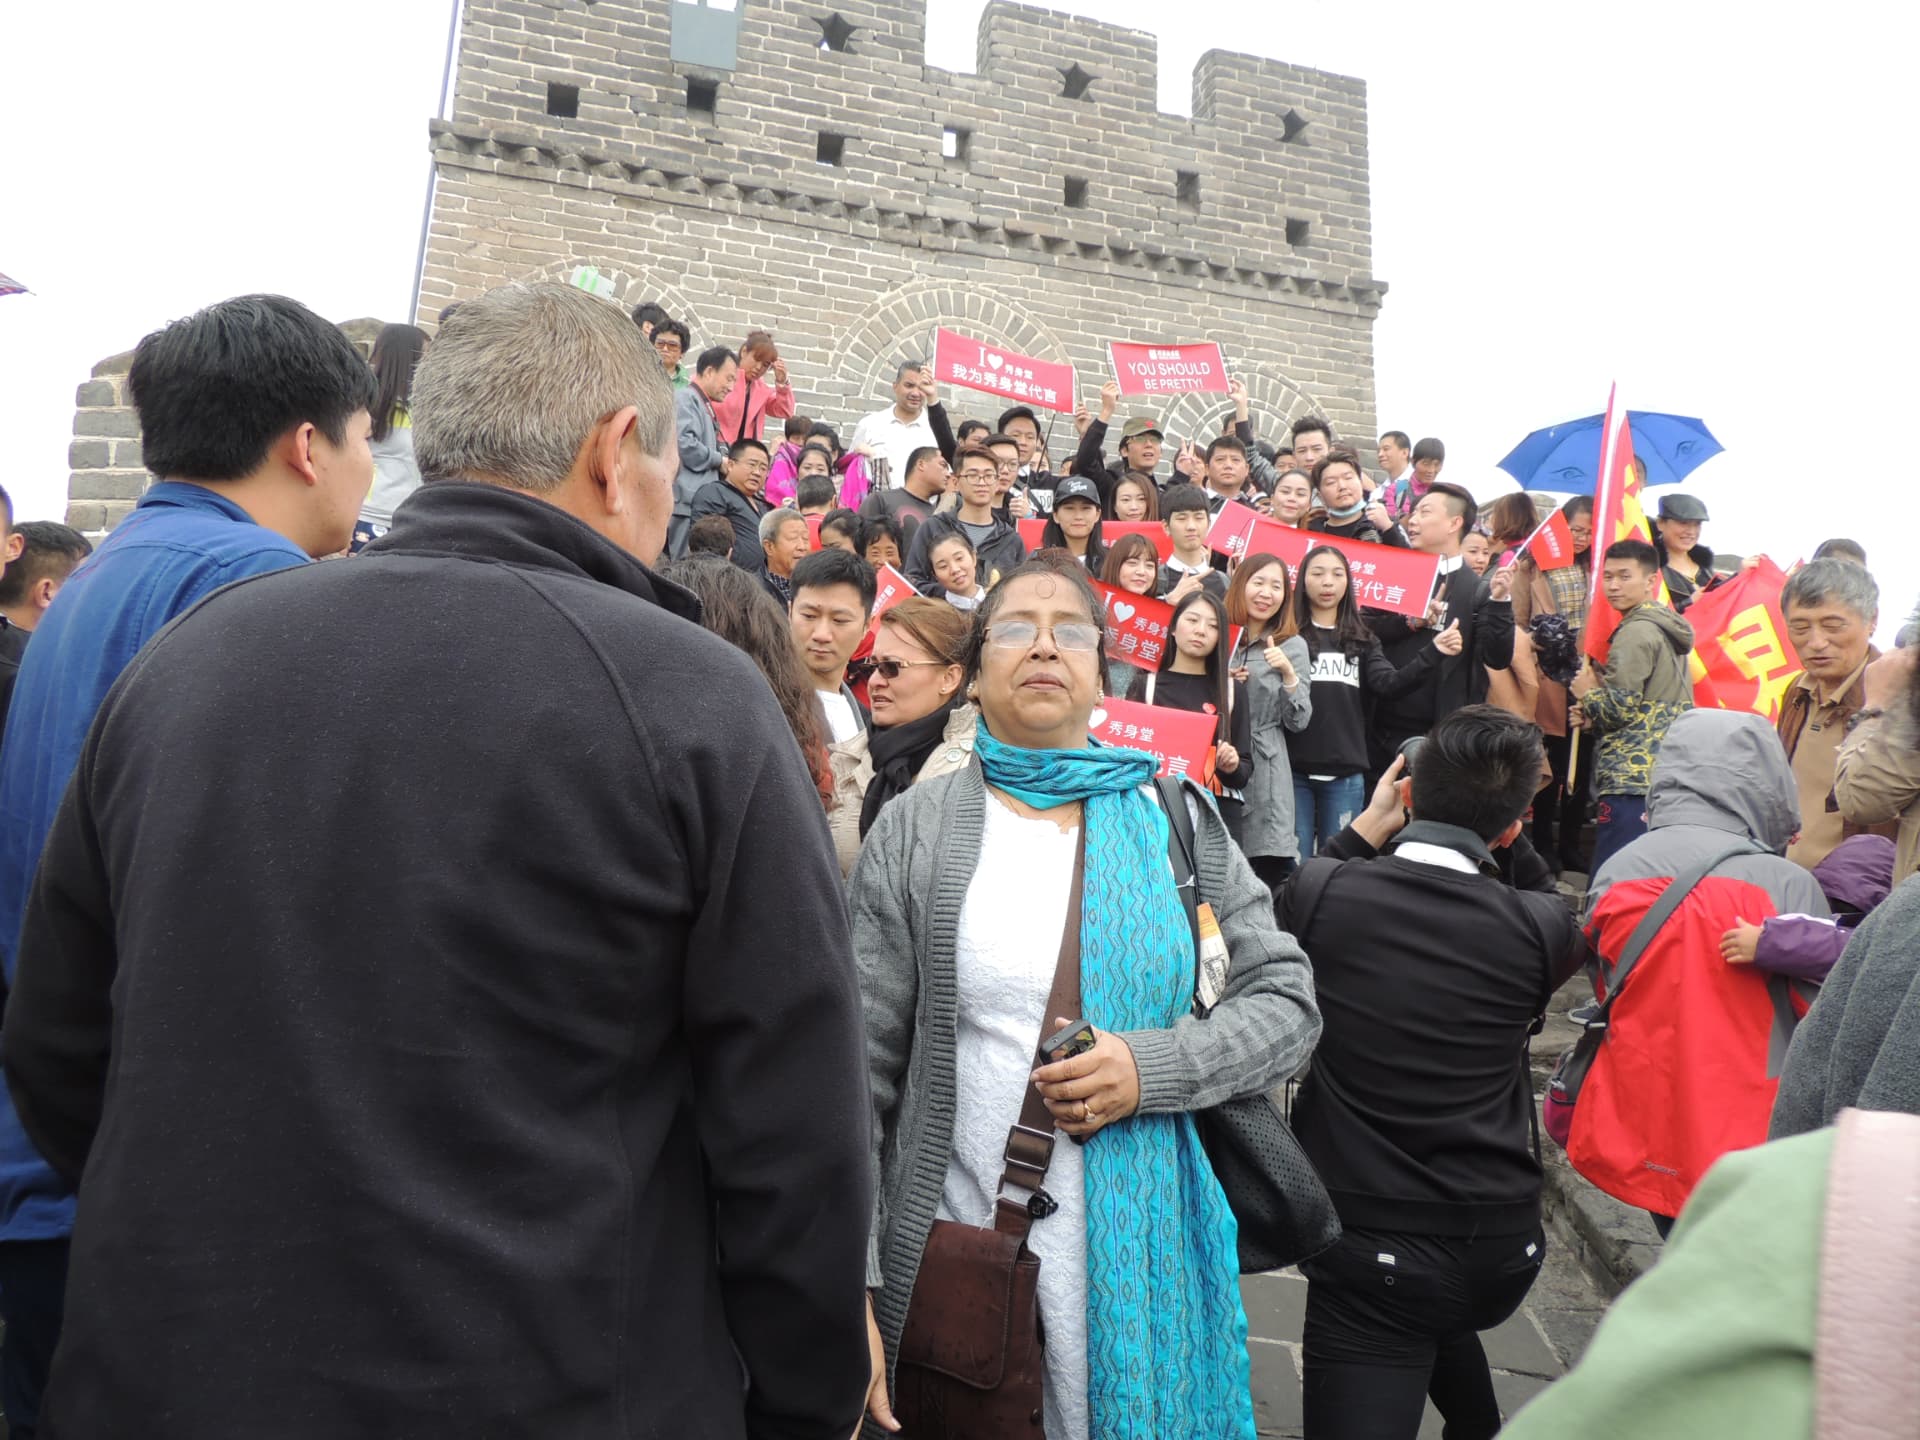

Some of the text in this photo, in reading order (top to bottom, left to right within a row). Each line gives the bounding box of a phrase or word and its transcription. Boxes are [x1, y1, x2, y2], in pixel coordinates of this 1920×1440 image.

[978, 346, 987, 368] I
[1128, 362, 1211, 376] YOU SHOULD
[952, 363, 1057, 404] 我为秀身堂代言
[1144, 378, 1203, 390] BE PRETTY!
[1108, 720, 1155, 743] 秀身堂
